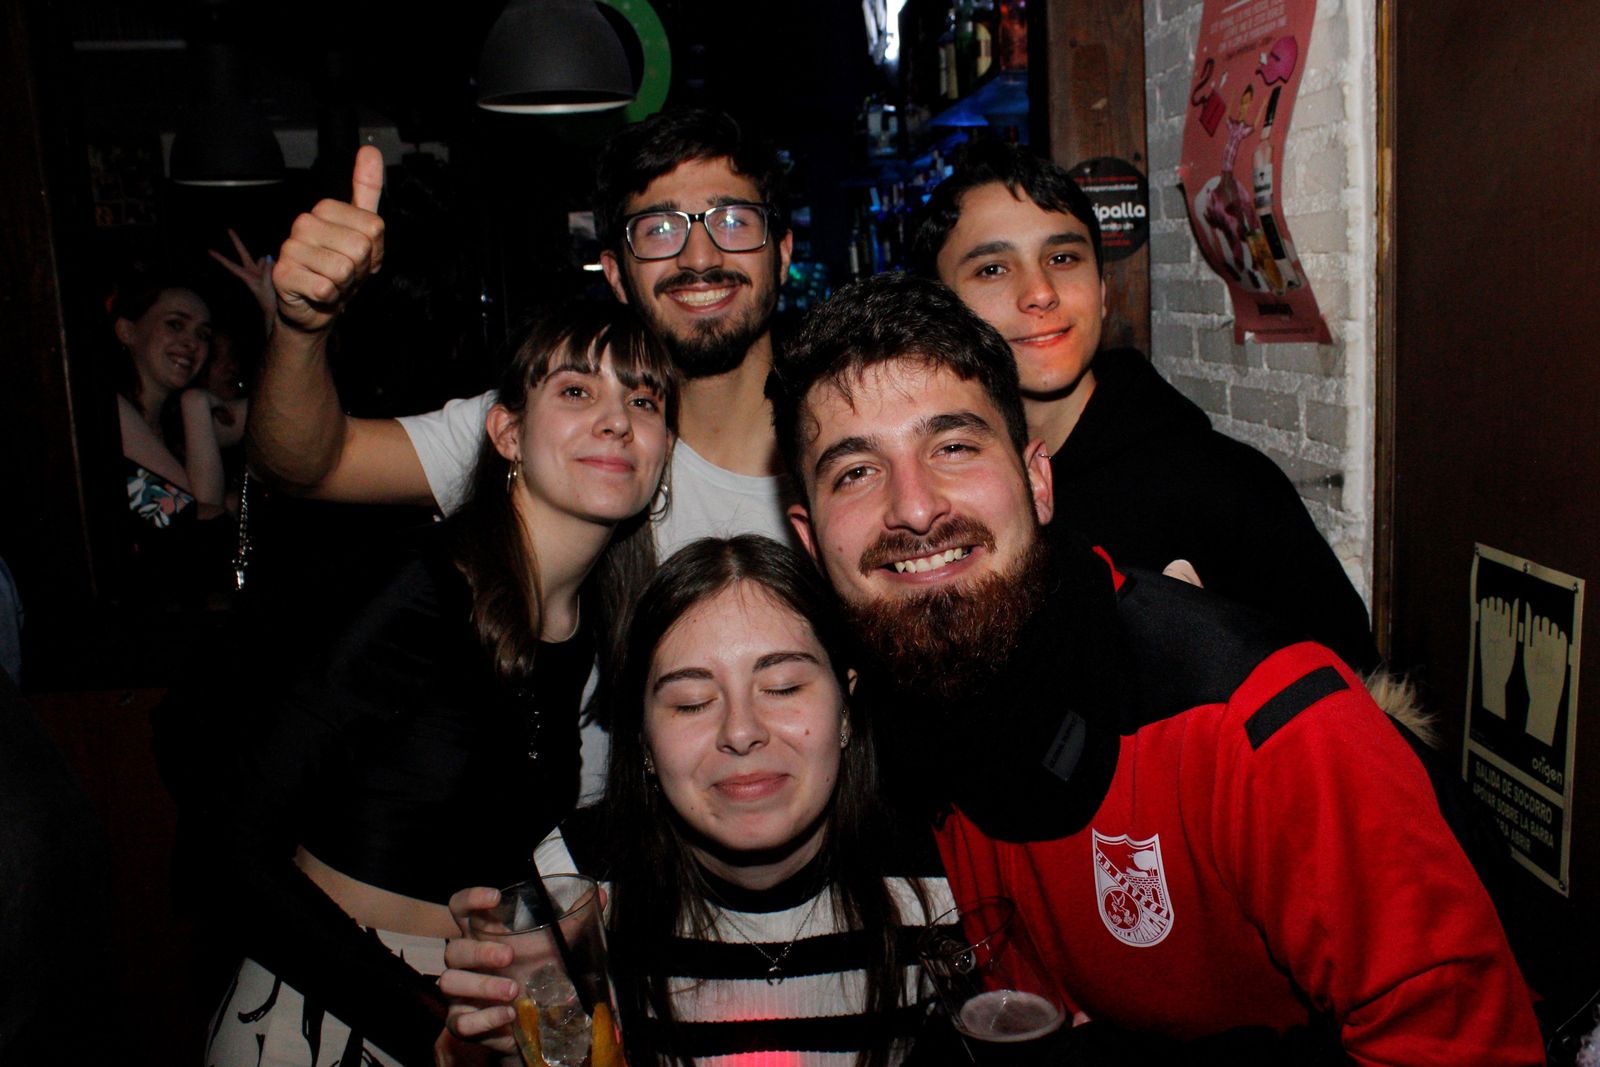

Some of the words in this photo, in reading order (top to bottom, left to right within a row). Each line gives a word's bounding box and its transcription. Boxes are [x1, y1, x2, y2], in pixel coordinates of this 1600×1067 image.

[1092, 201, 1146, 222] ipalla
[1532, 756, 1563, 785] origen
[1475, 760, 1501, 790] SALIDA
[1502, 777, 1513, 799] DE
[1513, 786, 1553, 825] SOCORRO
[1496, 798, 1519, 825] SOBRE
[1519, 813, 1529, 832] LA
[1530, 821, 1555, 849] BARRA
